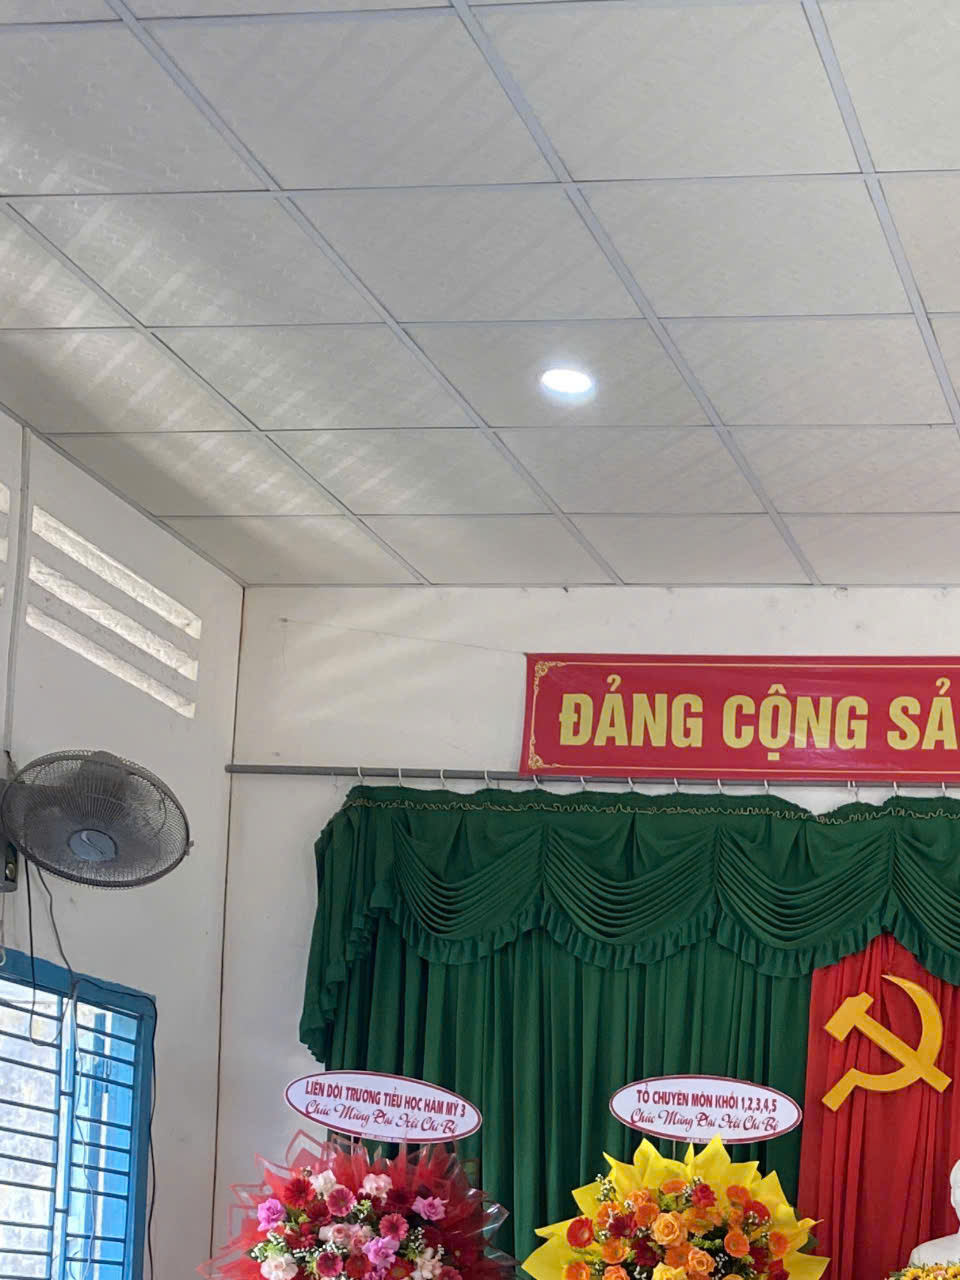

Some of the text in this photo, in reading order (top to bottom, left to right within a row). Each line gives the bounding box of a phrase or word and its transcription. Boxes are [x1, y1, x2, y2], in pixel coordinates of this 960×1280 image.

[559, 674, 703, 747] ĐẢNG
[721, 684, 868, 761] CỘNG
[460, 1103, 466, 1118] 3
[742, 1097, 777, 1114] 1,2,3,4,5
